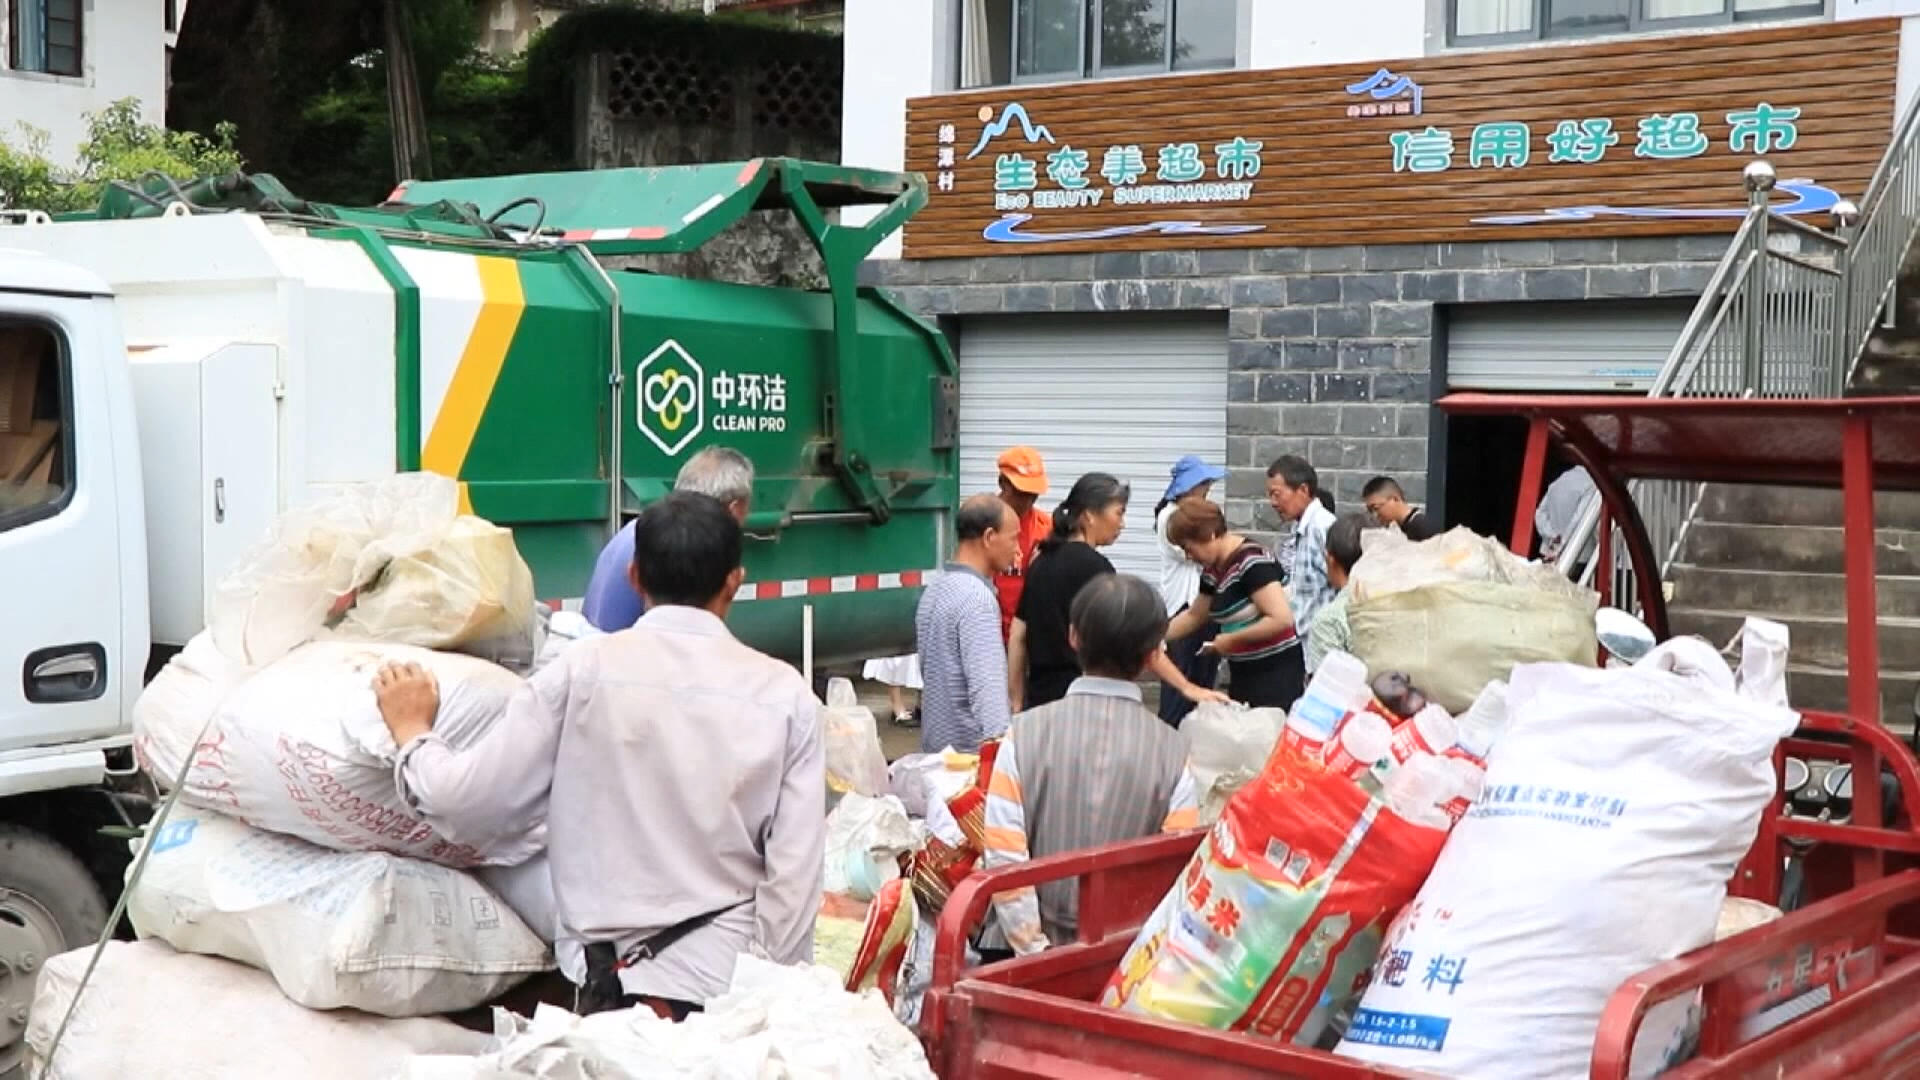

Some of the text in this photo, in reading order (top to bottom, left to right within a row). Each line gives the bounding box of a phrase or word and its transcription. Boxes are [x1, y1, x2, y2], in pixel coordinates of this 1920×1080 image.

[1389, 102, 1801, 173] 信用好超市
[994, 136, 1264, 191] 生态美超市
[1033, 188, 1104, 208] BEAUTY
[1113, 182, 1254, 205] SUPERMARKET
[711, 370, 787, 412] 中环洁
[712, 415, 786, 432] CLEAN PRO
